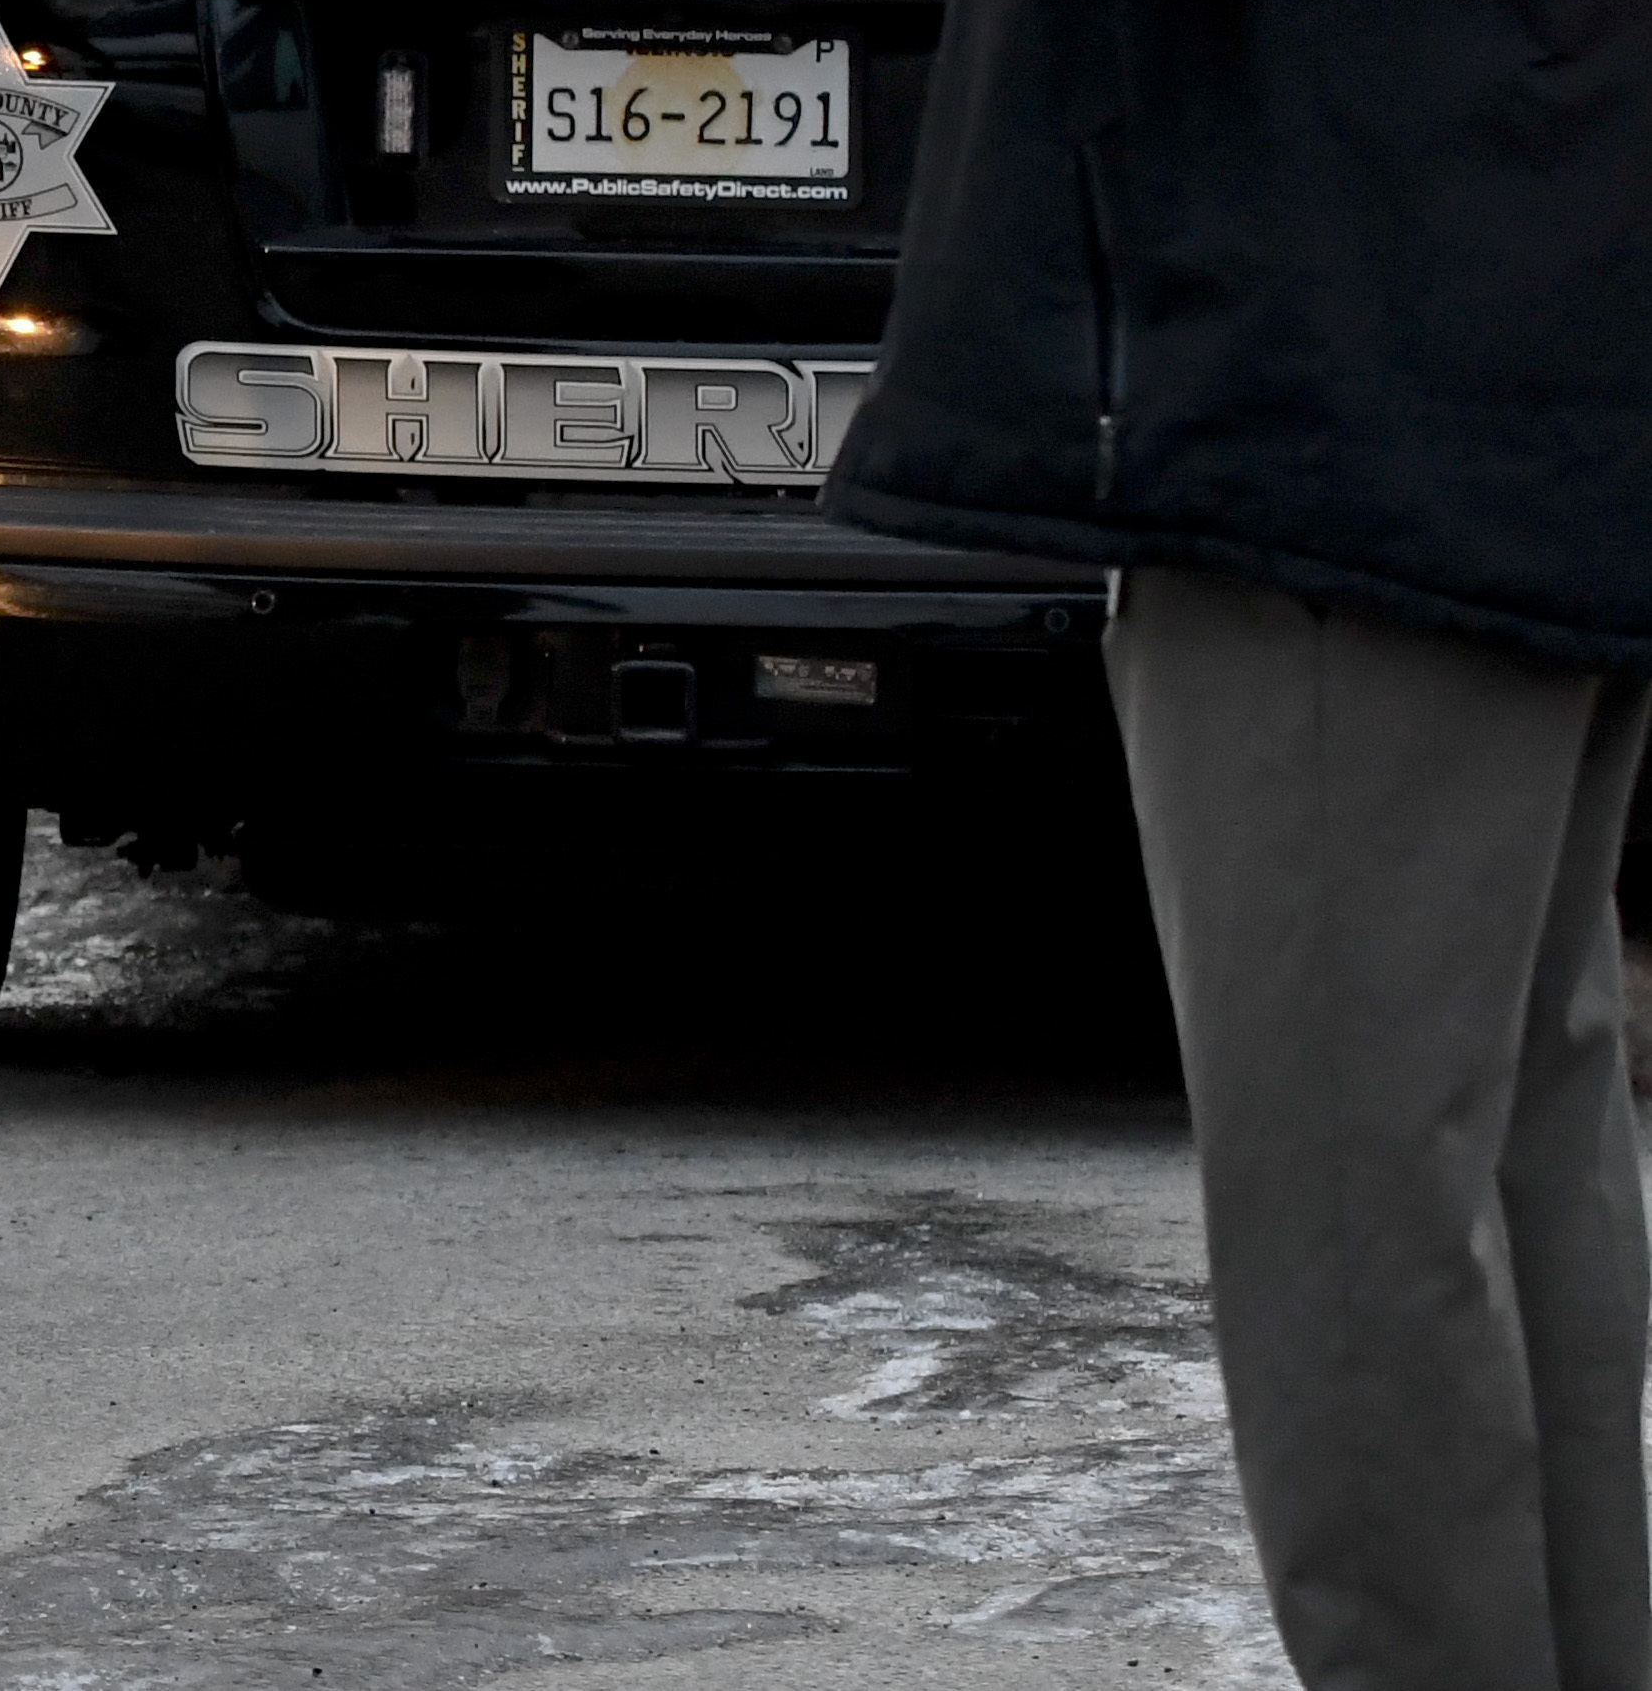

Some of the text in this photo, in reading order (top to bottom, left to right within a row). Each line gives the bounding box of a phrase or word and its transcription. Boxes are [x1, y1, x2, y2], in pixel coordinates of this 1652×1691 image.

[582, 28, 773, 44] Serving Everyday Heroes
[512, 32, 527, 172] SHERIF
[547, 86, 840, 149] S16-2191
[506, 178, 849, 201] www.PublicSafetyDirect.com
[177, 342, 878, 485] SHERI
